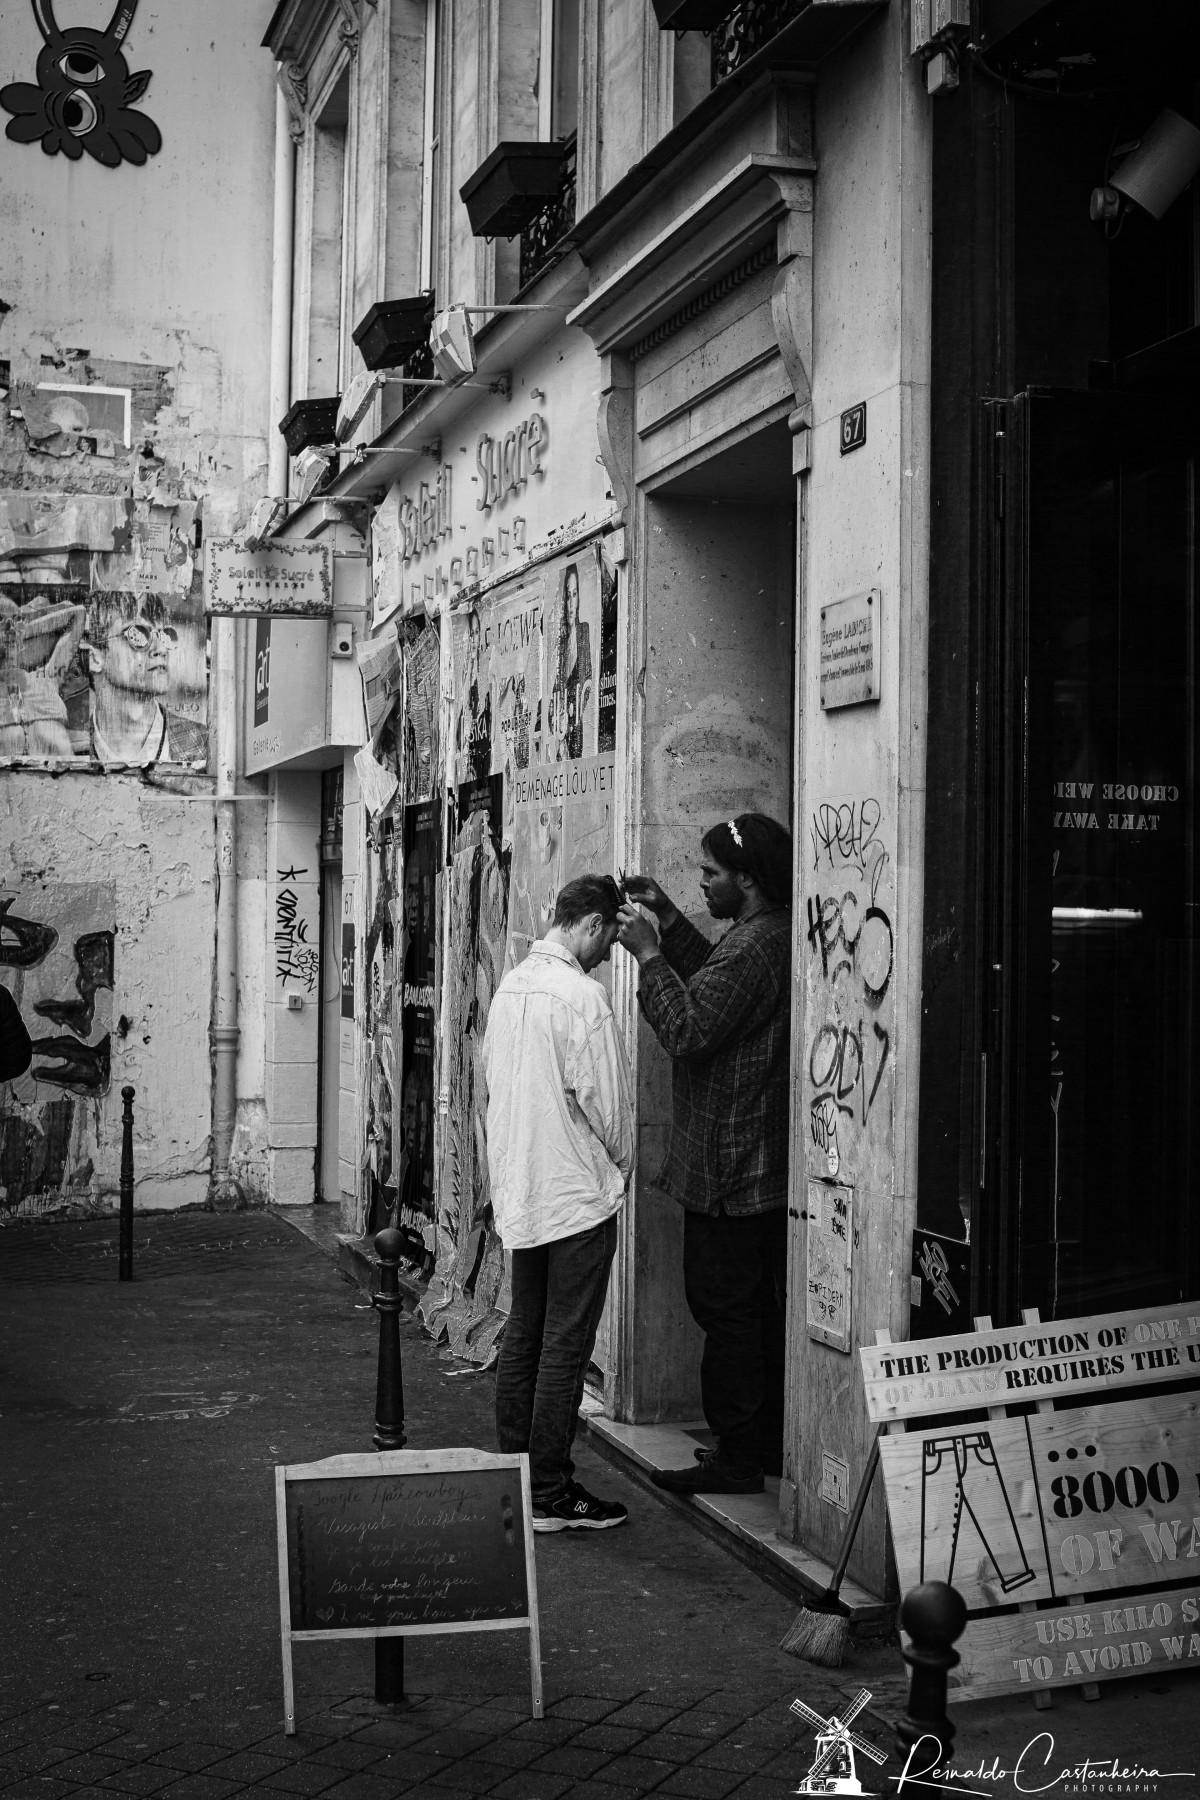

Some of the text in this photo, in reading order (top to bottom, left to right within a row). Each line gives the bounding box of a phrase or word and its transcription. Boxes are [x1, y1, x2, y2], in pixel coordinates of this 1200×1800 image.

[843, 411, 861, 444] 67
[139, 573, 158, 581] MARS
[228, 566, 315, 582] Soleil Sucré
[880, 1355, 930, 1379] THE
[937, 1328, 1091, 1371] PRODUCTION
[1097, 1326, 1127, 1348] OF
[1134, 1318, 1181, 1343] ONE
[885, 1382, 914, 1406] OF
[923, 1372, 999, 1401] JEANS
[1005, 1354, 1126, 1389] REQUIRES
[1130, 1347, 1180, 1371] THE
[1051, 1461, 1180, 1519] 8000
[1060, 1528, 1124, 1576] OF
[1035, 1614, 1094, 1645] USE
[1101, 1602, 1173, 1635] KILO
[1013, 1655, 1054, 1683] TO
[1062, 1641, 1152, 1677] AVOID
